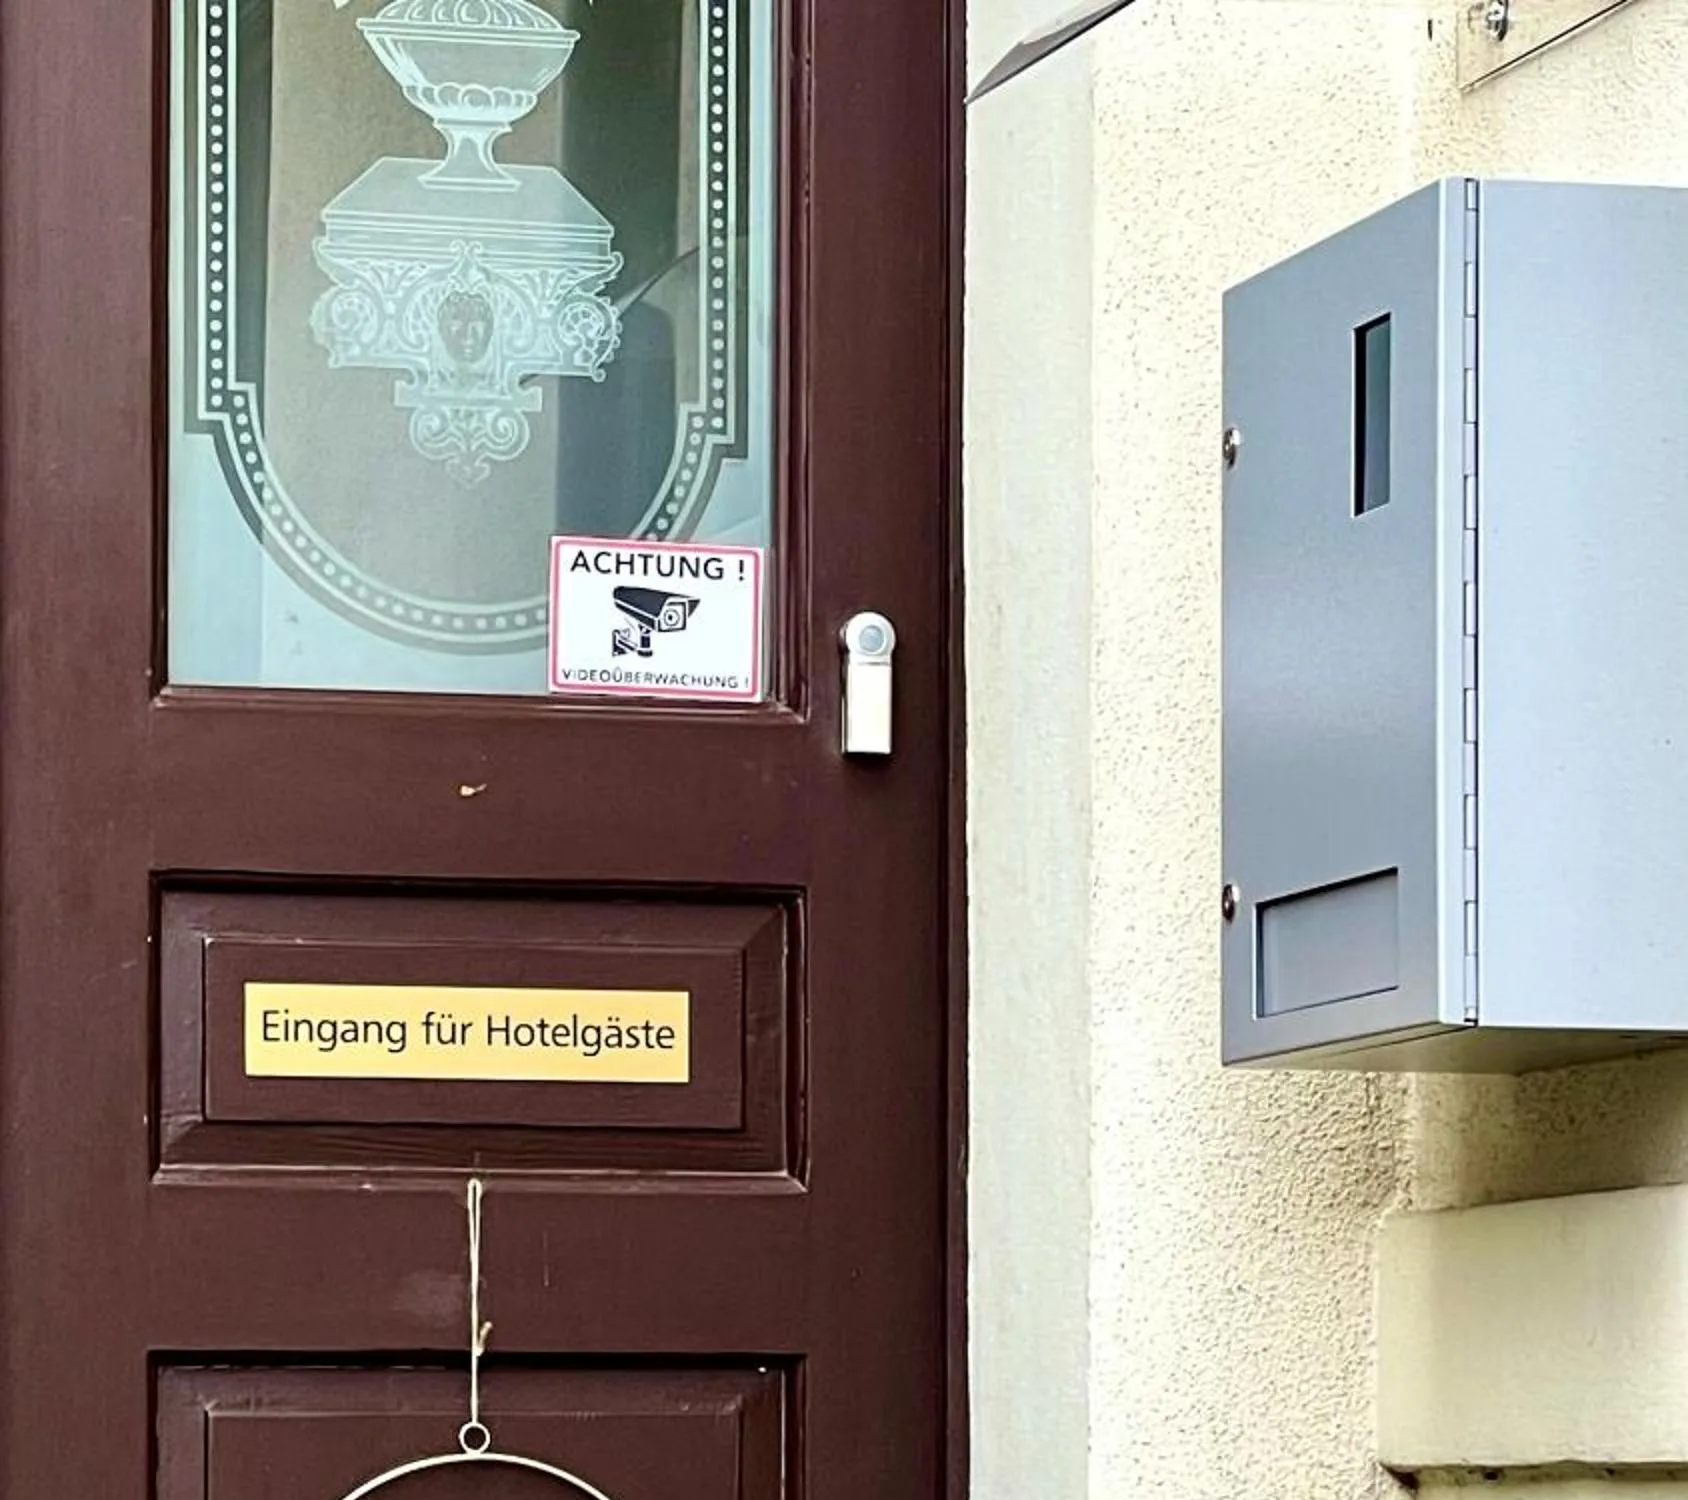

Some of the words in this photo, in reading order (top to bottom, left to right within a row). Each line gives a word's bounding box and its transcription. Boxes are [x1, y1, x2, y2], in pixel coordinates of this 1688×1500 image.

[570, 549, 725, 581] ACHTUNG
[562, 666, 739, 689] VIDEOÜBERWACHUNG
[262, 1008, 407, 1052] Eingang
[421, 1011, 473, 1047] für
[486, 1014, 676, 1057] Hotelgäste
